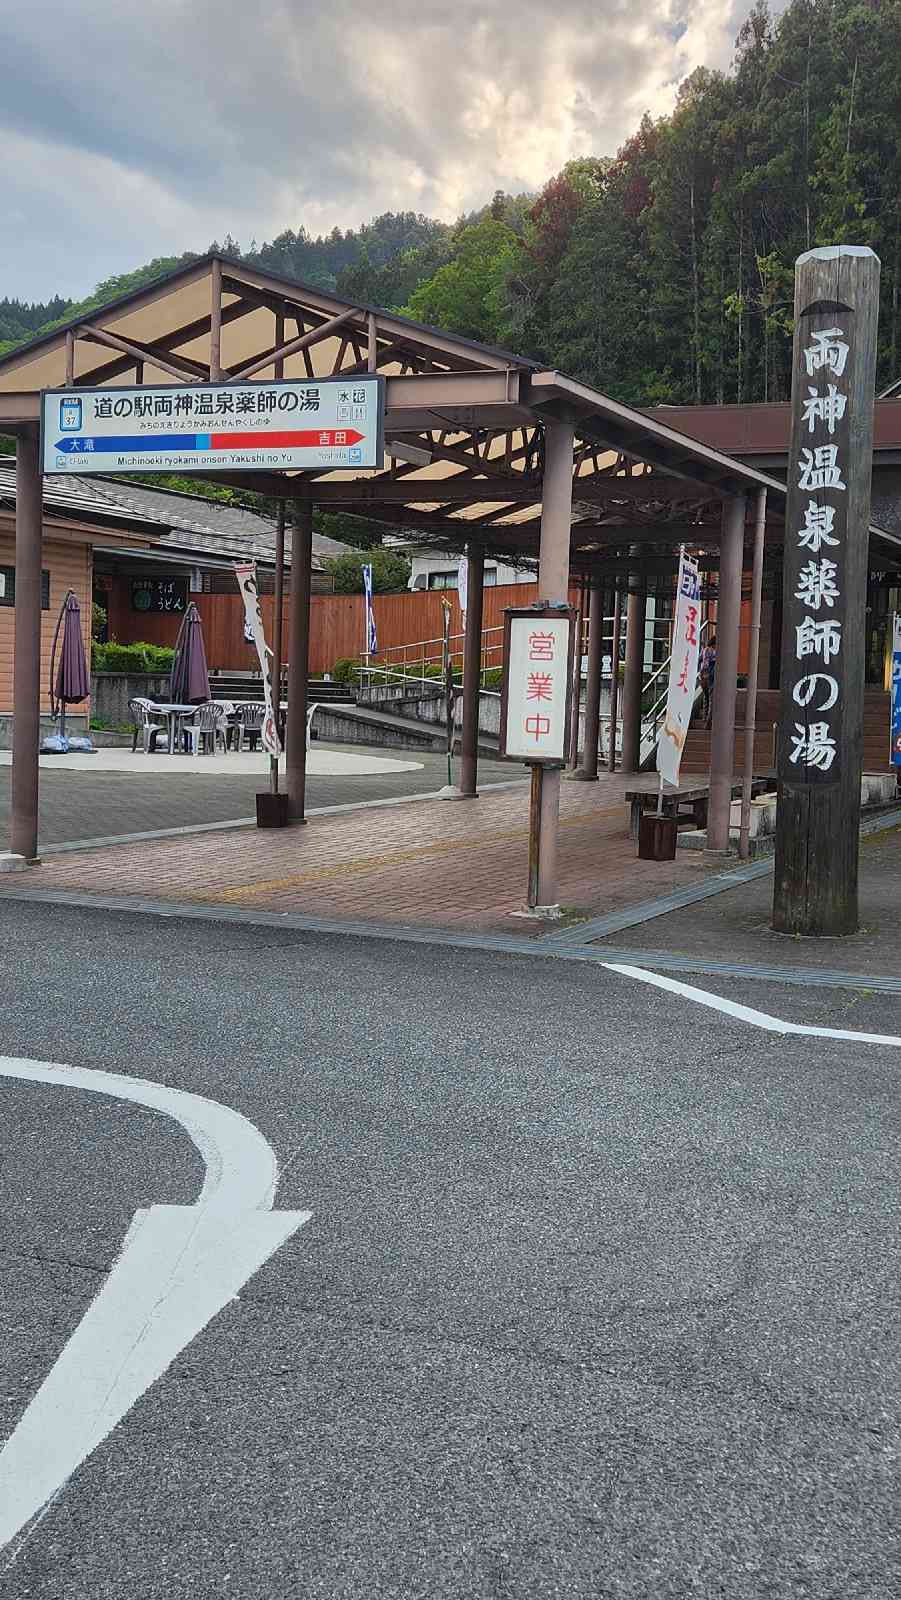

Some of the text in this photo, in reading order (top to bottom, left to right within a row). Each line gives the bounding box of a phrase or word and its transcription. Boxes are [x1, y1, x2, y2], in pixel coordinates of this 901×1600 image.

[94, 389, 320, 418] 道の駅両神温泉薬師の湯
[65, 416, 76, 425] 37
[319, 431, 347, 445] 吉田
[230, 453, 265, 463] Yakushi
[268, 455, 279, 463] no
[281, 453, 292, 462] Yu
[788, 327, 849, 772] 両神温泉薬師の湯
[525, 631, 556, 742] 営業中
